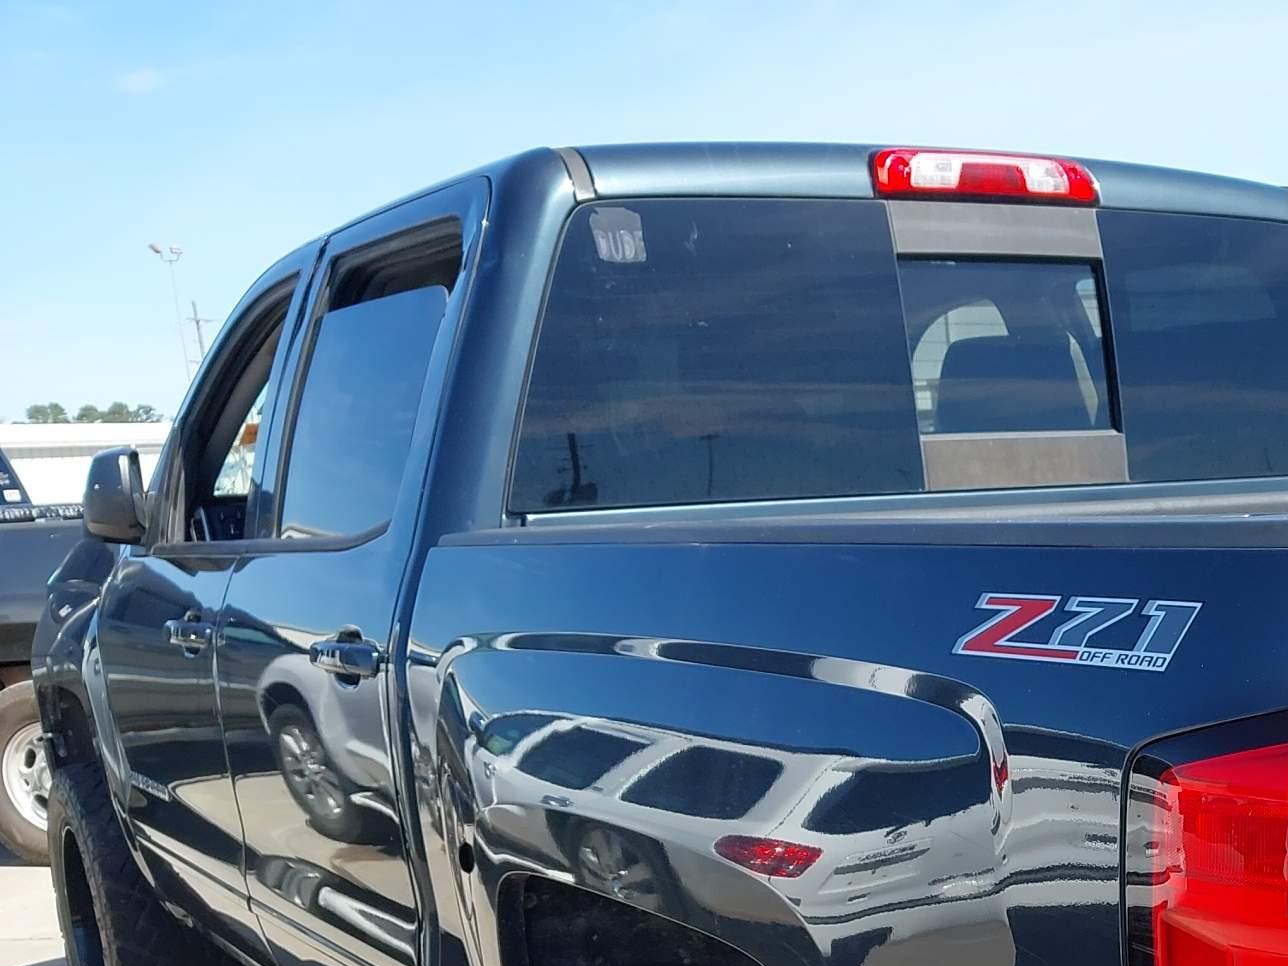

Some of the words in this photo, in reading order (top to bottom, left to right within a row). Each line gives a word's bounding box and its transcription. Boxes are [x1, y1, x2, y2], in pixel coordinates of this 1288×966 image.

[952, 592, 1204, 664] Z71
[1079, 650, 1113, 665] OFF
[1115, 653, 1167, 669] ROAD
